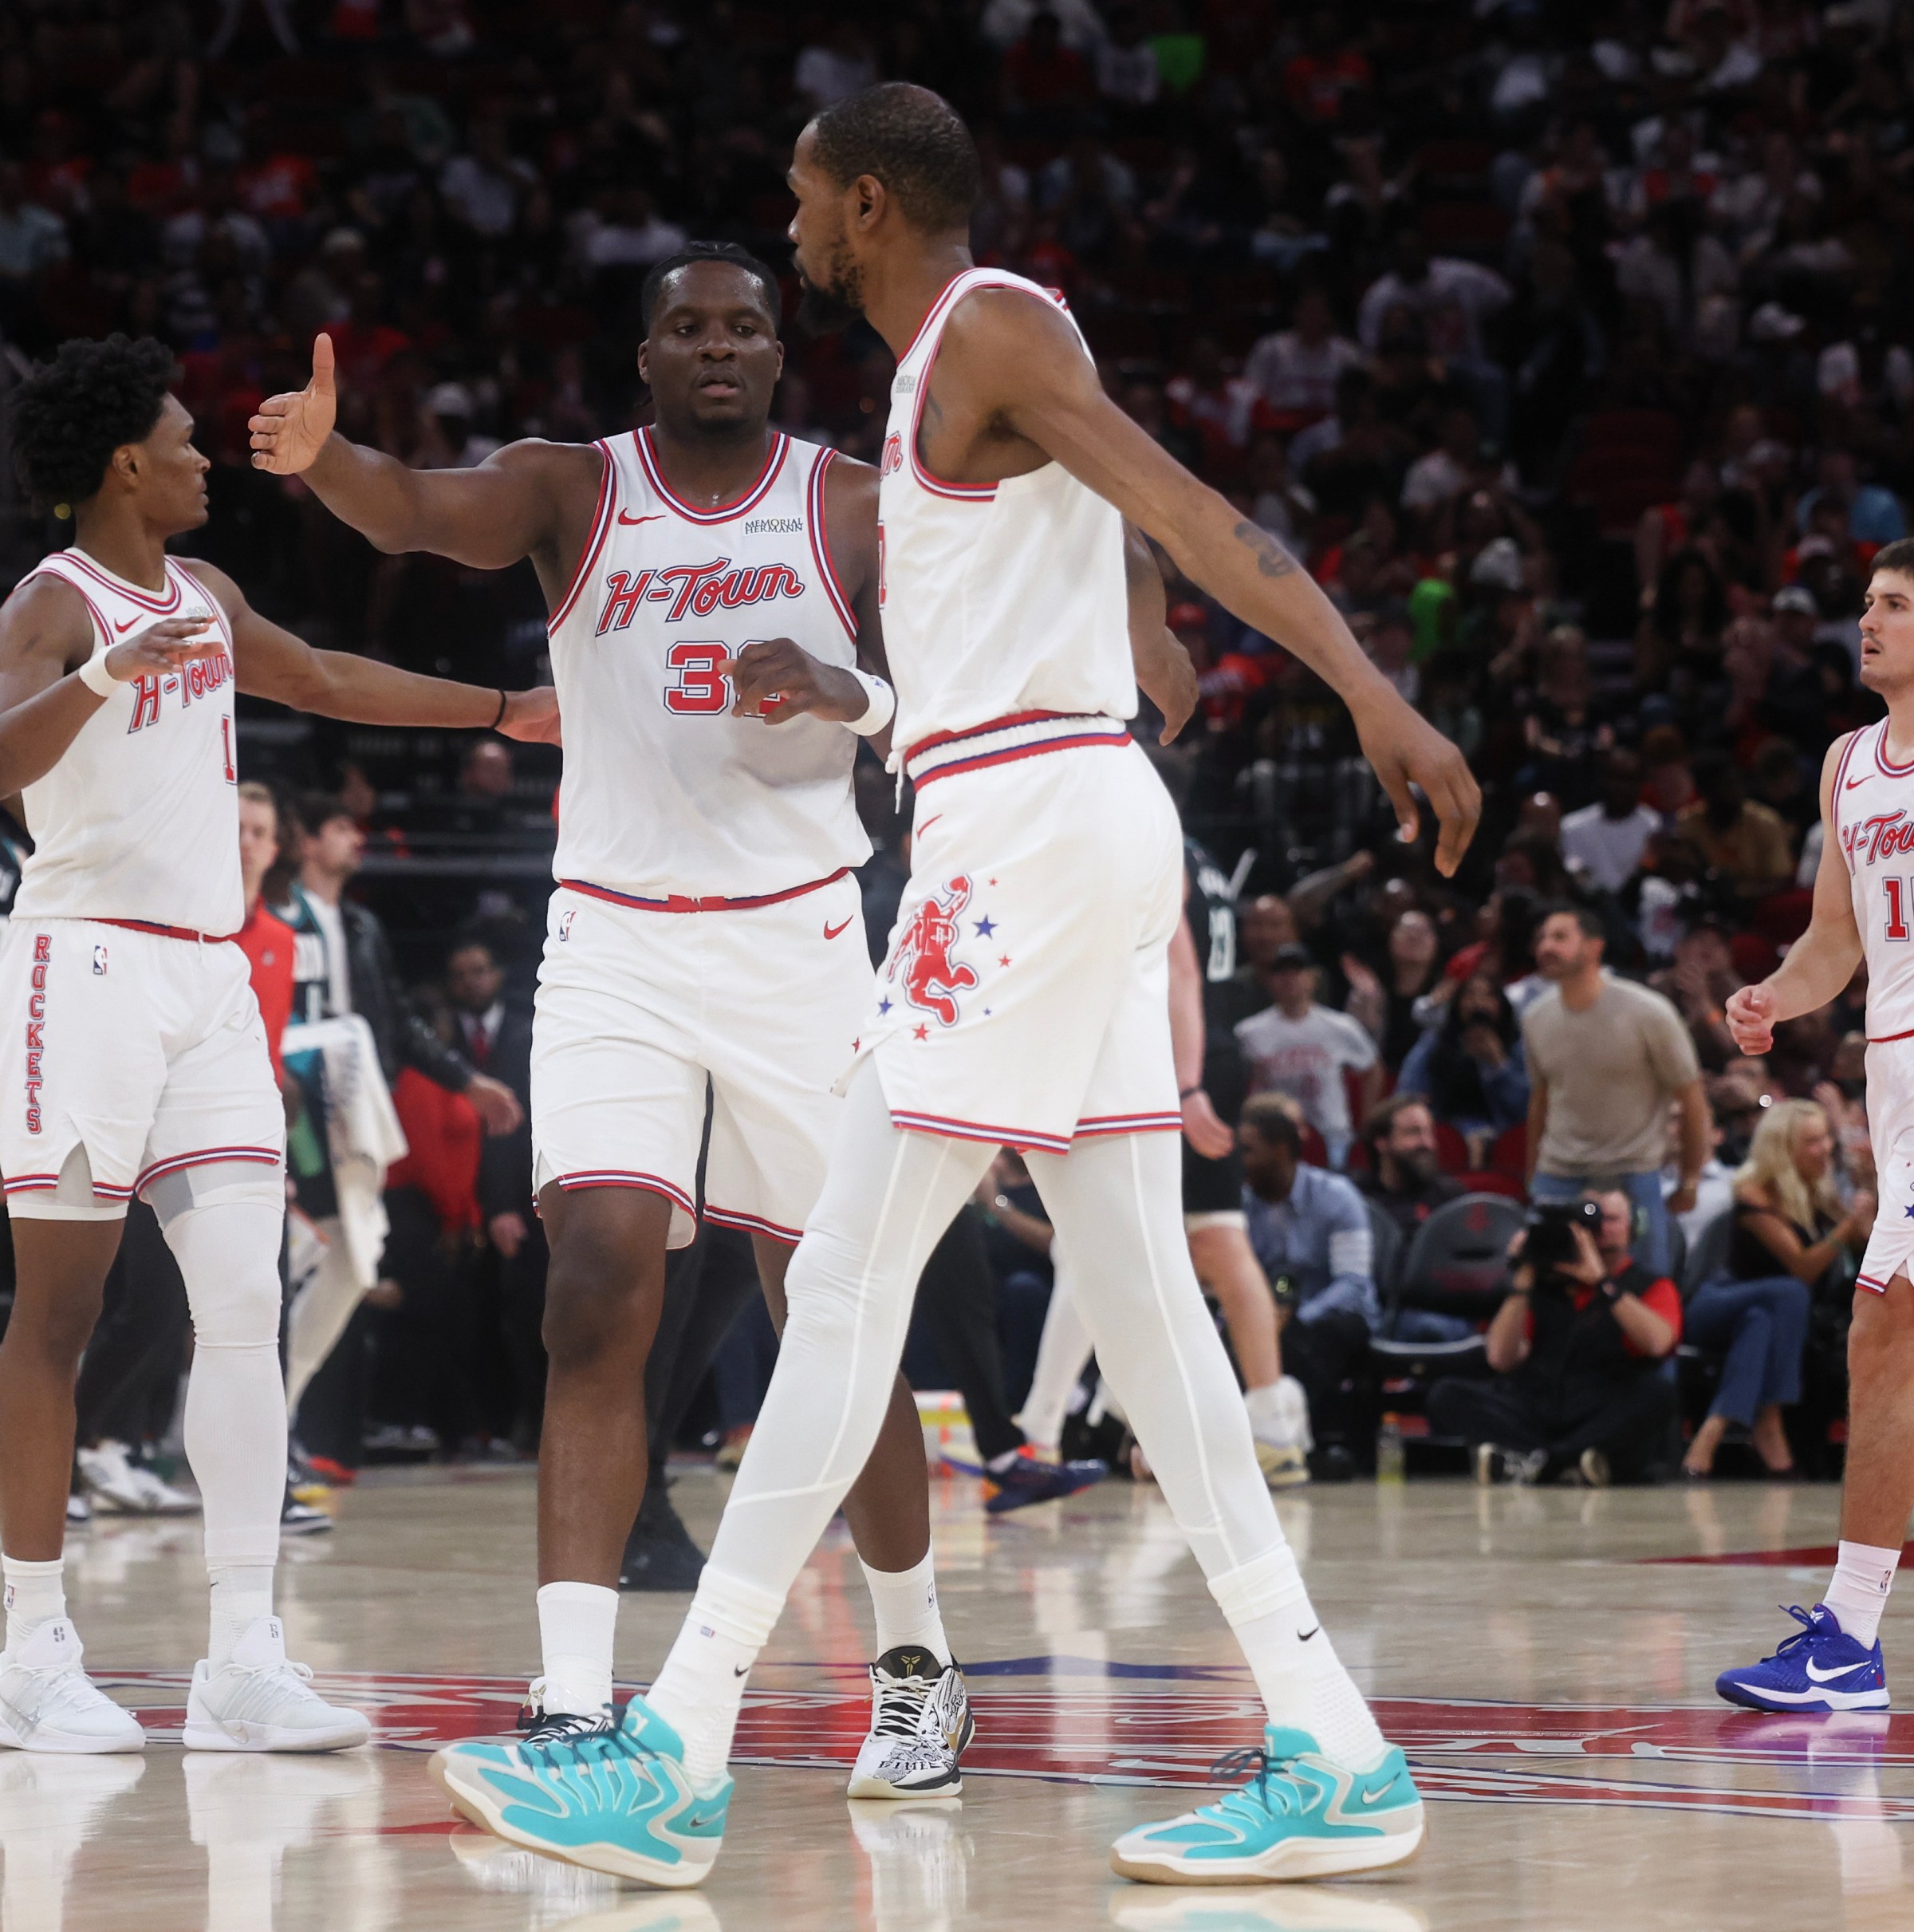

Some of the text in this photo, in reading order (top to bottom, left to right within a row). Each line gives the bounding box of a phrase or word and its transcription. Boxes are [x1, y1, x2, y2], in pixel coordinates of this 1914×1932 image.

[745, 518, 803, 527] MEMORIAL
[745, 523, 802, 534] HERMANN
[595, 557, 805, 638] H-Town
[1882, 877, 1914, 941] 1
[25, 934, 52, 1134] ROCKETS
